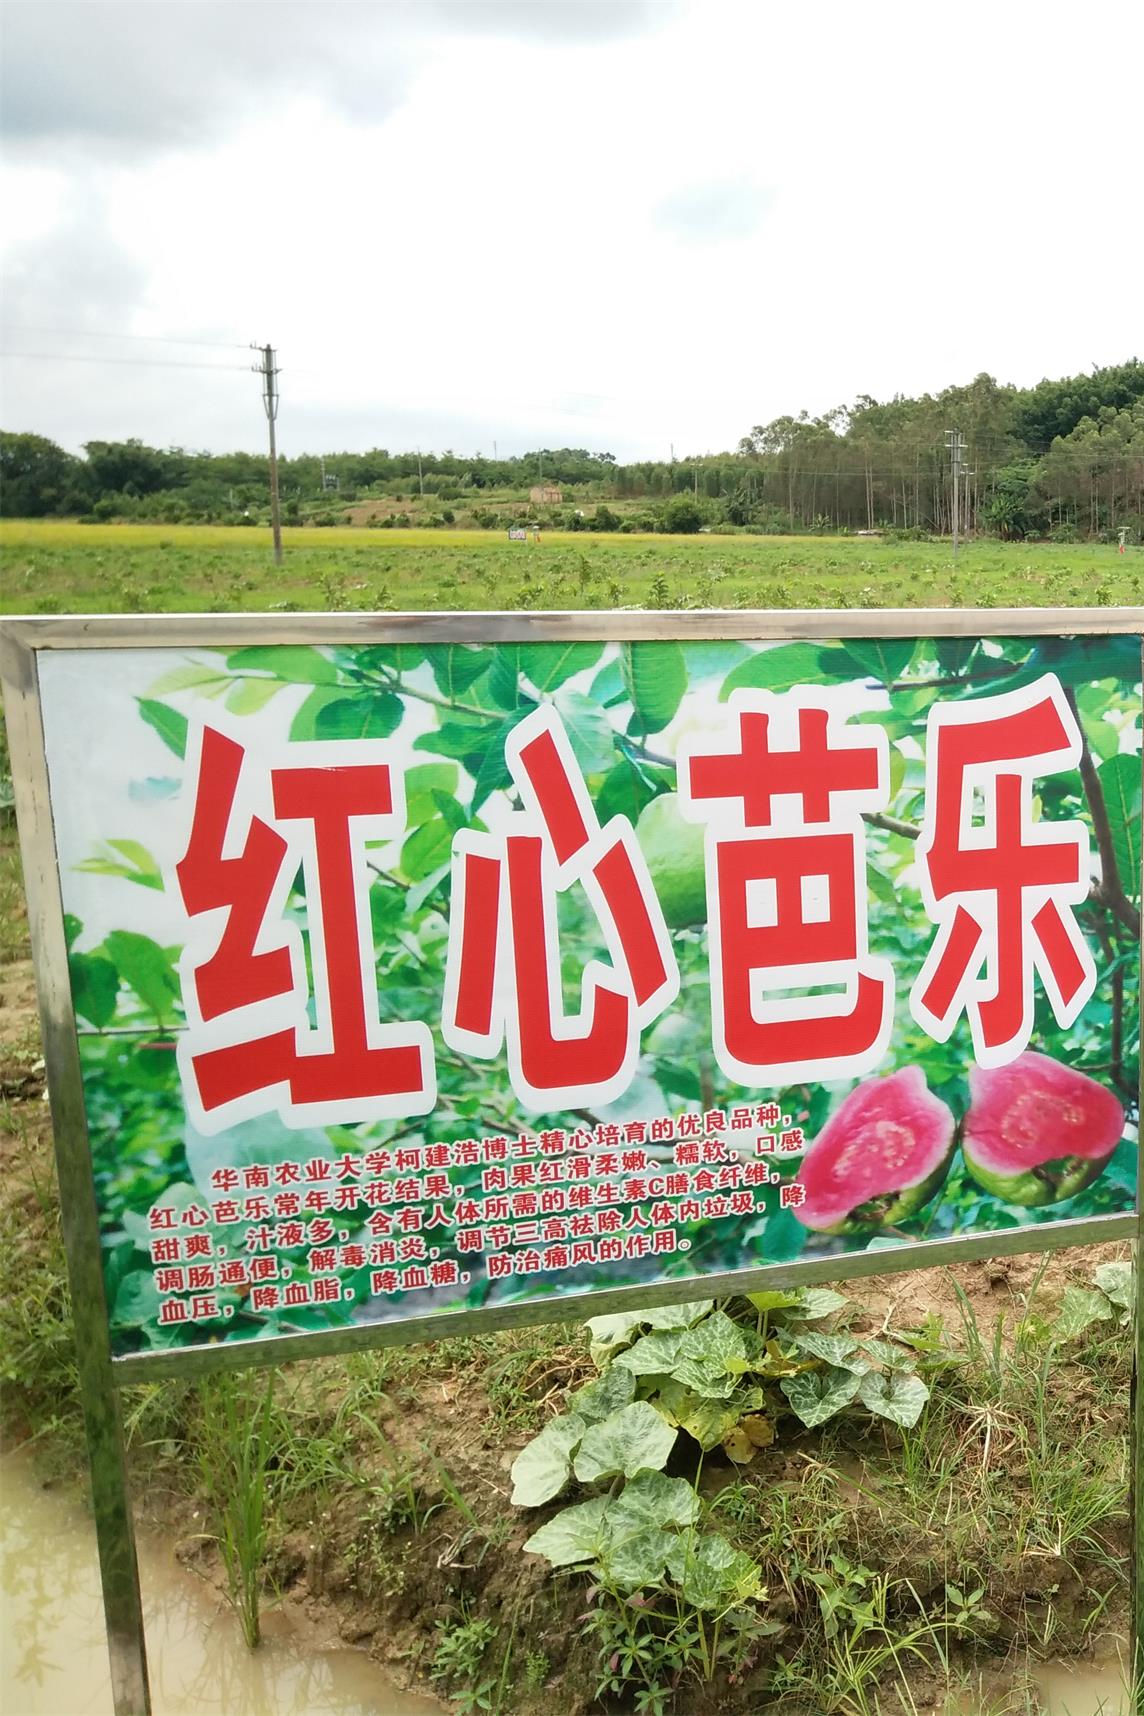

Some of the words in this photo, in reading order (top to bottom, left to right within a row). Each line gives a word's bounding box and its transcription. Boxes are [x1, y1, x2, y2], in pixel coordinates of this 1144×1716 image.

[177, 694, 1087, 1113] 红心芭乐
[212, 1104, 793, 1192] 华南农业大学柯建浩博士精心培育的优良品种，
[159, 1230, 693, 1324] 血压，降血脂，降血糖，防治痛风的作用。
